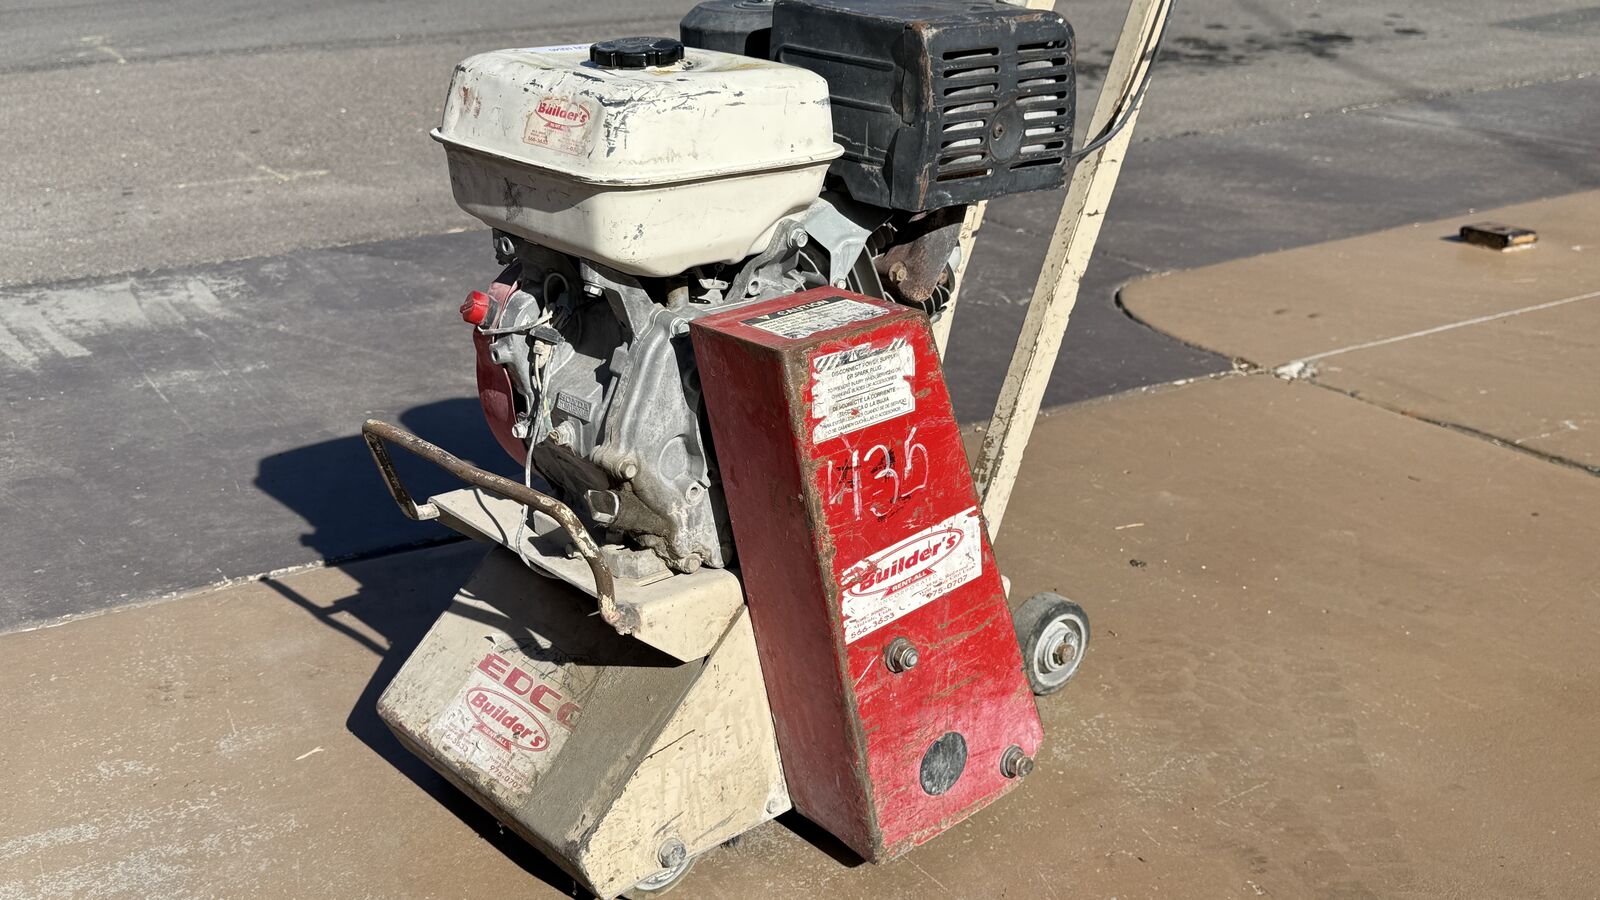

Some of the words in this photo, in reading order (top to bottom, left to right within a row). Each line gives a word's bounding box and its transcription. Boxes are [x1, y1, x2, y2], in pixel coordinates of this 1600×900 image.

[538, 103, 587, 122] Builder's
[778, 300, 829, 315] CAUTION
[832, 364, 861, 377] DISCONNECT
[854, 369, 869, 377] SPARK
[870, 365, 882, 373] PLUG
[871, 387, 896, 399] CORRIENTE
[860, 535, 956, 592] Builder's
[470, 692, 545, 748] Builder's
